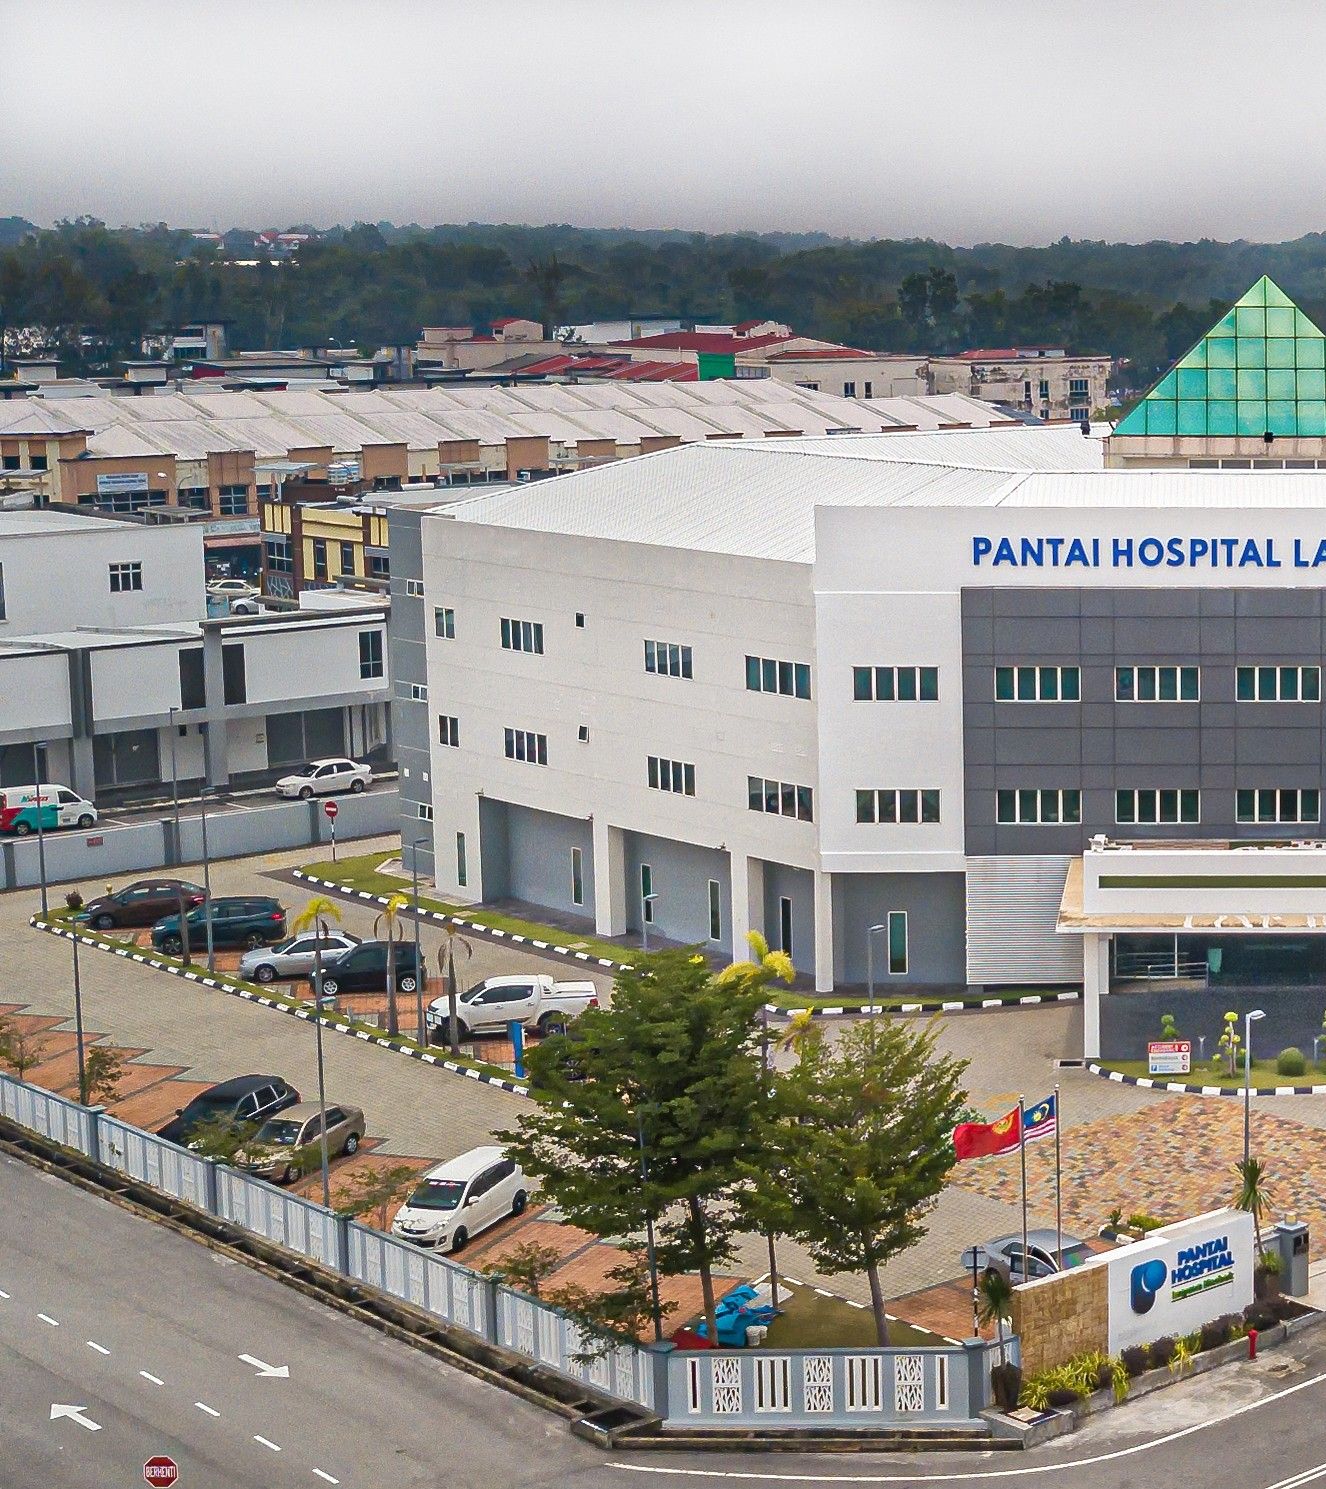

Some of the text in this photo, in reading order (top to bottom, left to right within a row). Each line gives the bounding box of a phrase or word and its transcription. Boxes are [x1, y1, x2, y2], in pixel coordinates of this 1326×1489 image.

[973, 537, 1100, 567] PANTAI
[1112, 538, 1282, 567] HOSPITAL
[1177, 1236, 1229, 1265] PANTAI
[1171, 1251, 1235, 1285] HOSPITAL
[146, 1466, 175, 1478] BERHENTI
